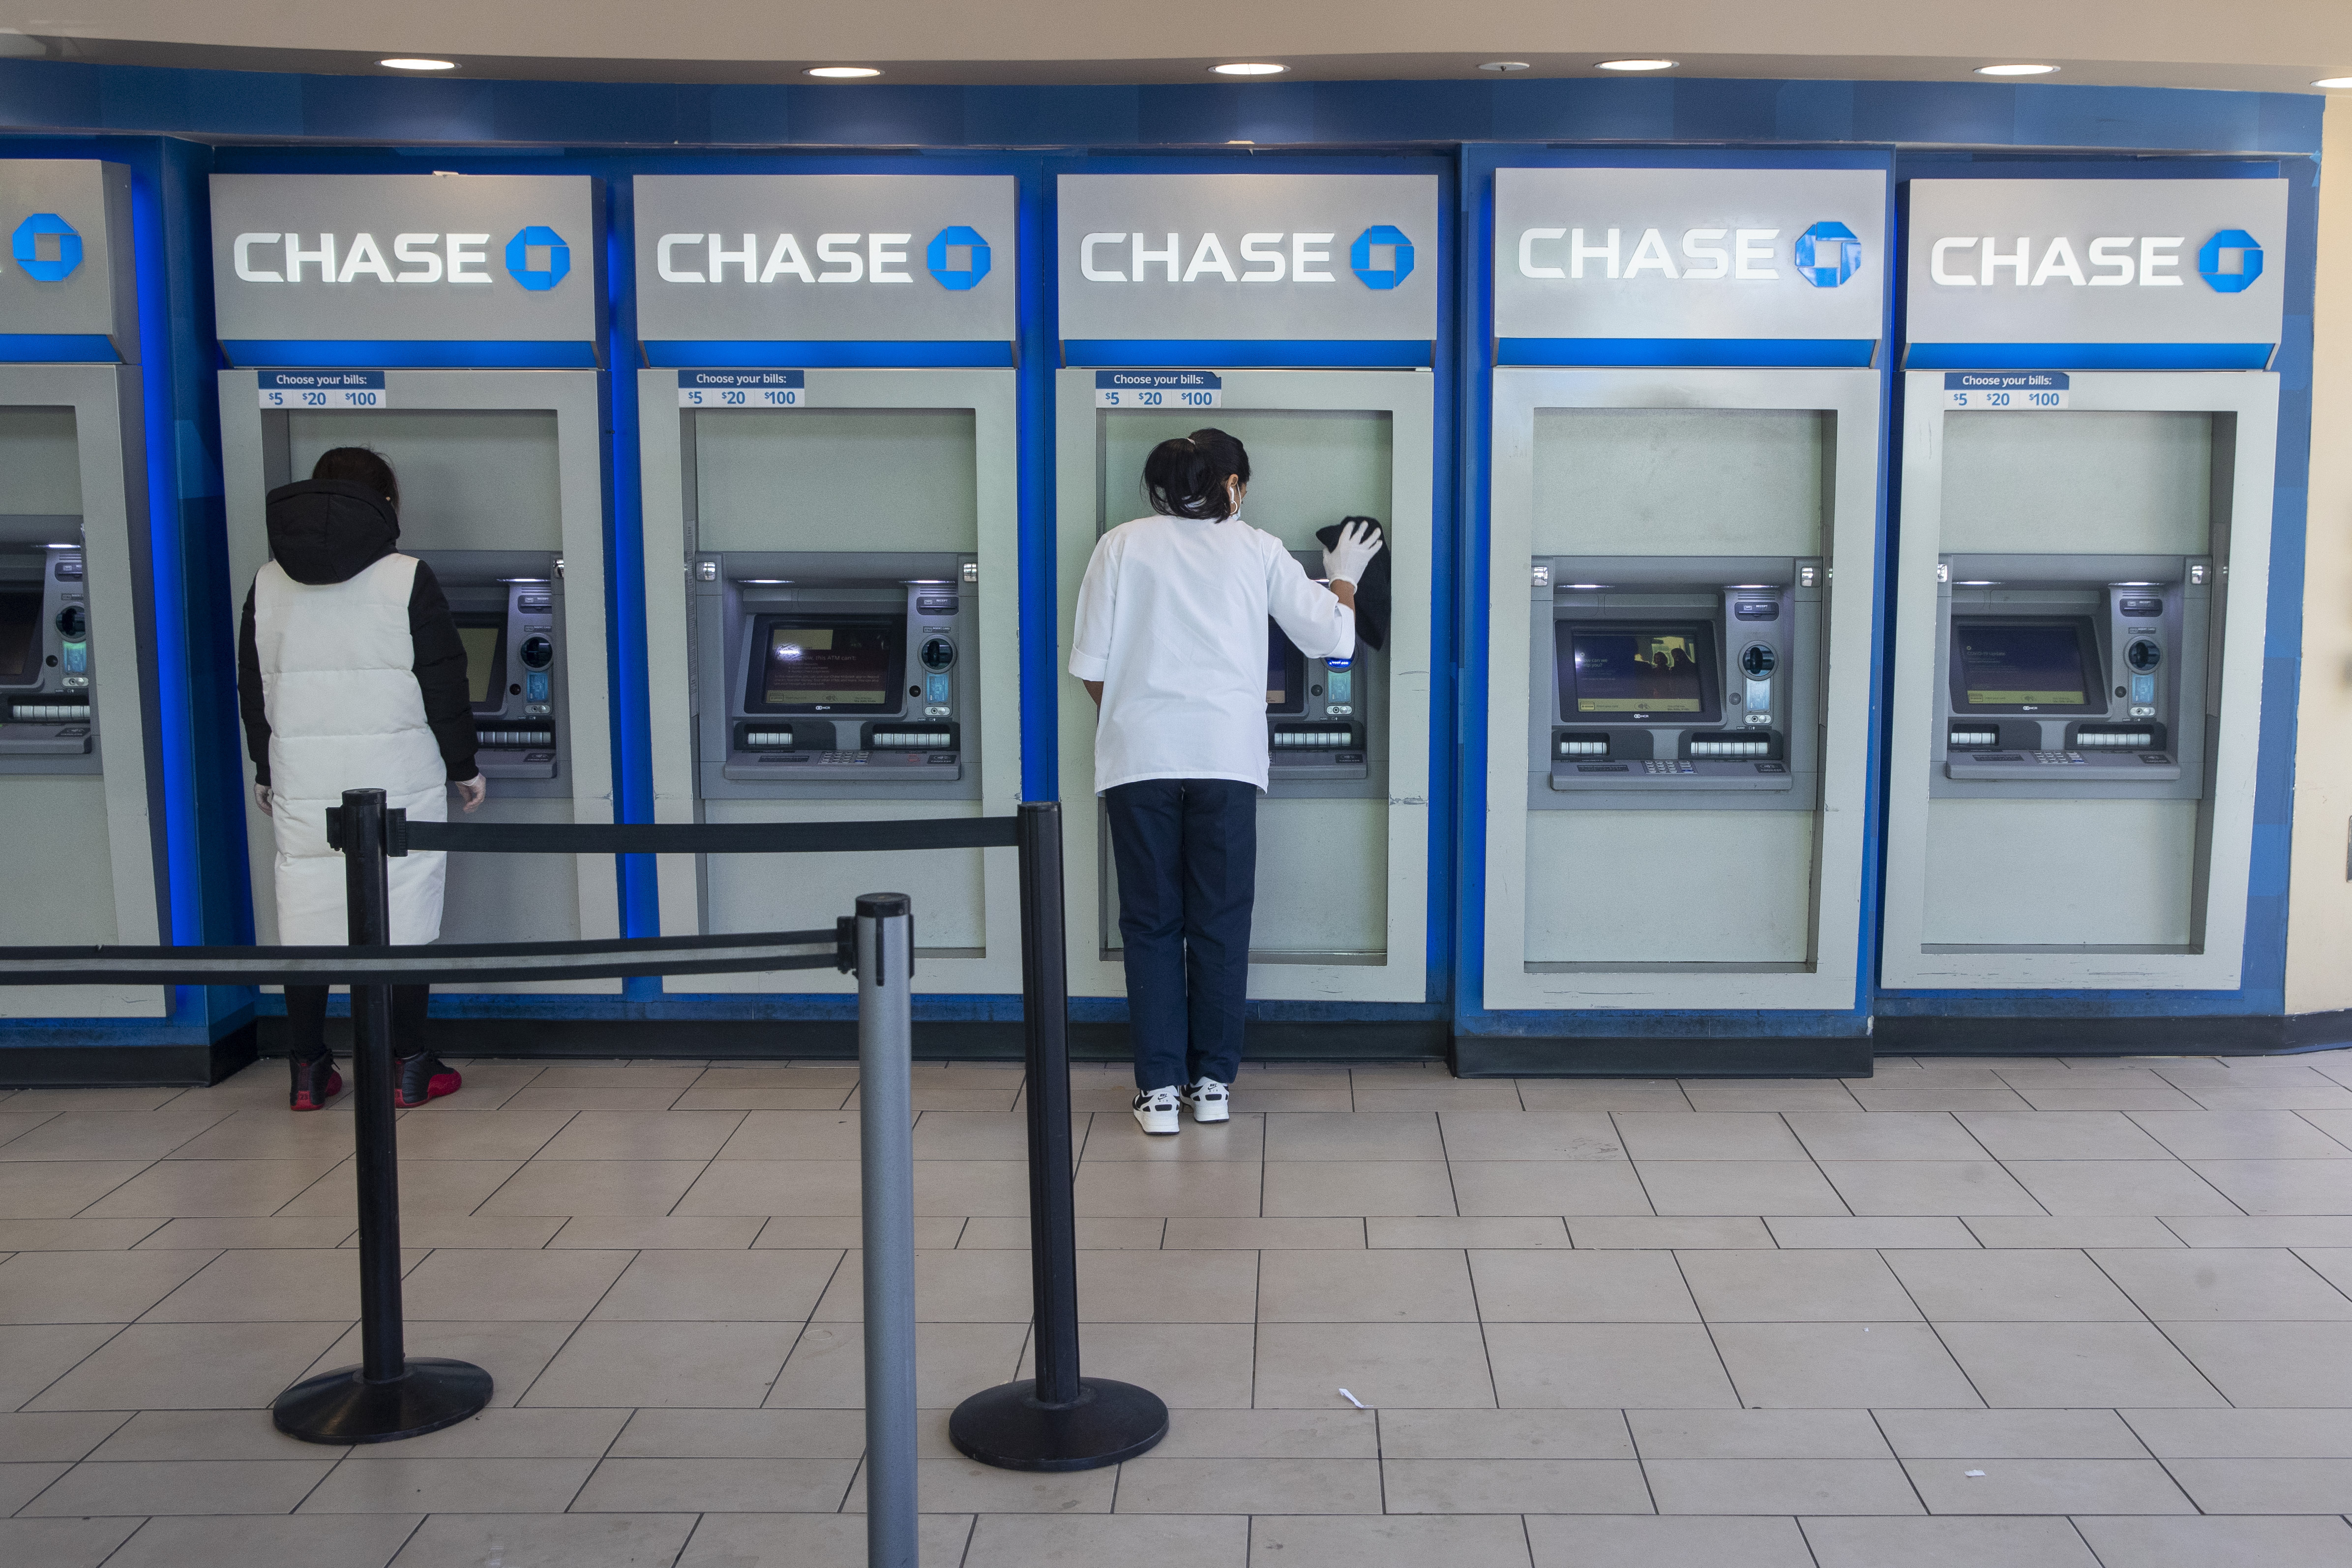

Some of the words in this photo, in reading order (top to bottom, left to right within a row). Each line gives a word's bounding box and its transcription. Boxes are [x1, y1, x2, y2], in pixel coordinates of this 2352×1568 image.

[235, 233, 492, 283] CHASE
[658, 234, 913, 282] CHASE
[1081, 233, 1336, 282] CHASE
[1519, 228, 1780, 280] CHASE
[1932, 237, 2184, 286] CHASE
[276, 374, 314, 384] Choose
[317, 377, 341, 386] your
[344, 374, 367, 384] bills:
[696, 373, 734, 383] Choose
[737, 376, 761, 385] your
[763, 373, 787, 383] bills:
[1114, 374, 1151, 384] Choose
[1154, 377, 1178, 385] your
[1181, 374, 1204, 384] bills:
[1963, 375, 2000, 385] Choose
[2002, 377, 2026, 387] your
[2029, 375, 2052, 385] bills:
[268, 392, 283, 405] $5
[302, 392, 327, 405] $20
[345, 392, 376, 405] $100
[688, 391, 703, 404] $5
[722, 391, 745, 404] $20
[765, 391, 795, 404] $100
[1105, 392, 1120, 405] $5
[1138, 392, 1162, 405] $20
[1181, 392, 1212, 405] $100
[1954, 393, 1967, 406] $5
[1987, 392, 2010, 406] $20
[2029, 393, 2059, 406] $100
